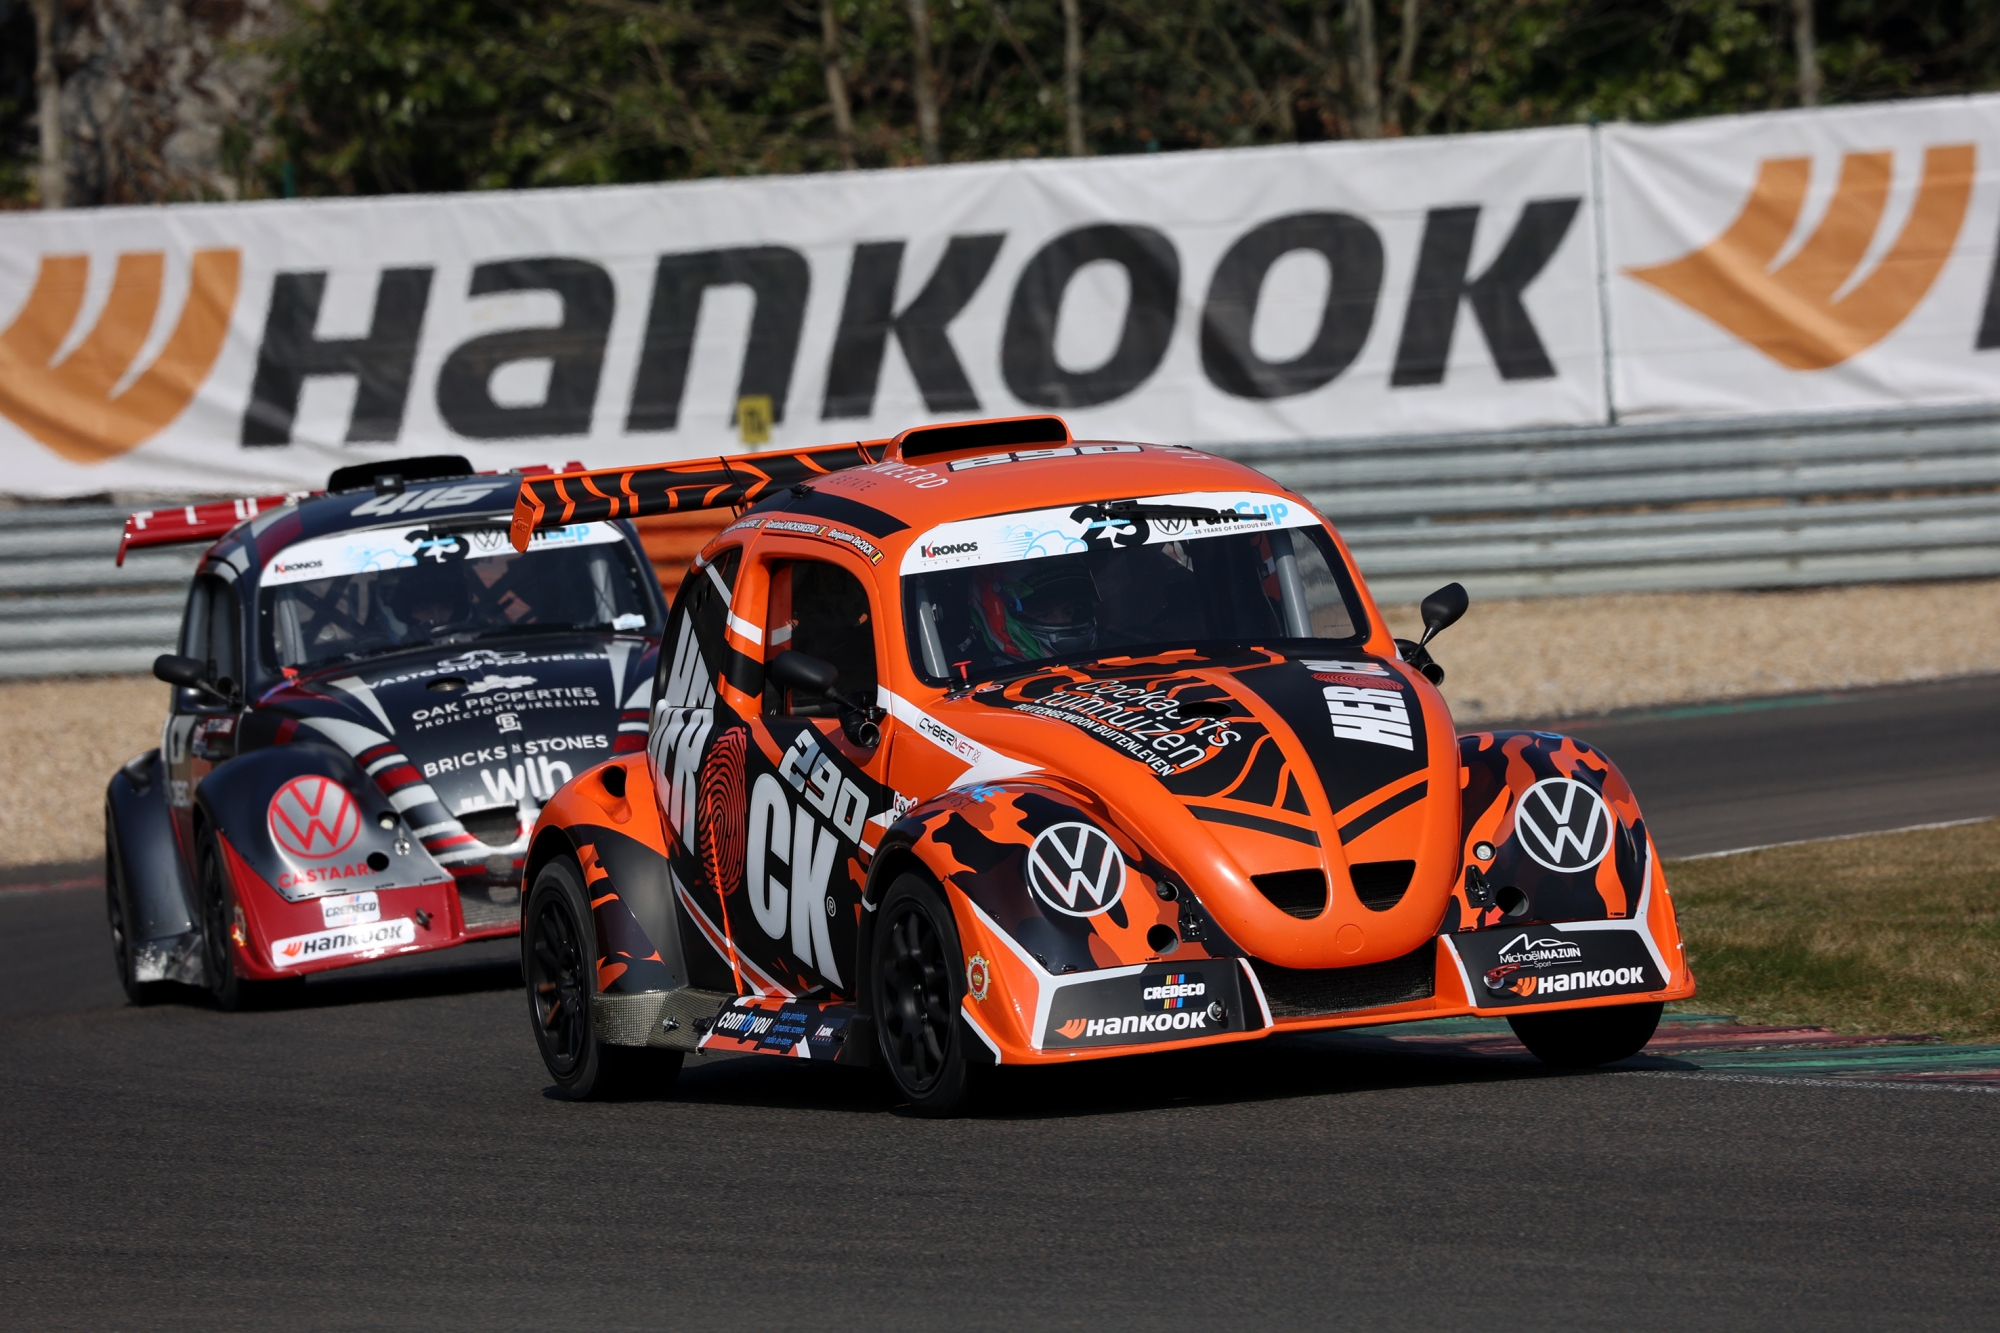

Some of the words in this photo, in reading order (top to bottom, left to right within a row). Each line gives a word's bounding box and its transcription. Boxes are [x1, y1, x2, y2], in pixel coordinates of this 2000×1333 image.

[350, 482, 512, 517] 415
[1203, 526, 1223, 534] YEARS
[1233, 521, 1260, 531] SERIOUS
[921, 540, 978, 558] KRONOS
[274, 559, 323, 574] KRONOS
[411, 701, 460, 721] OAK
[465, 686, 597, 709] PROPERTIES
[414, 698, 600, 732] PROJECTONTWIKKELING
[918, 717, 975, 757] CYBERNET
[1092, 724, 1176, 777] BUITENLEVEN
[423, 745, 508, 778] BRICKS
[524, 734, 609, 756] STONES
[778, 728, 870, 845] 290
[278, 861, 378, 889] CASTAAR
[325, 901, 377, 918] CREDECO
[1533, 960, 1552, 970] Sport
[1143, 982, 1205, 1001] CREDECO
[717, 1011, 774, 1037] comtoyou
